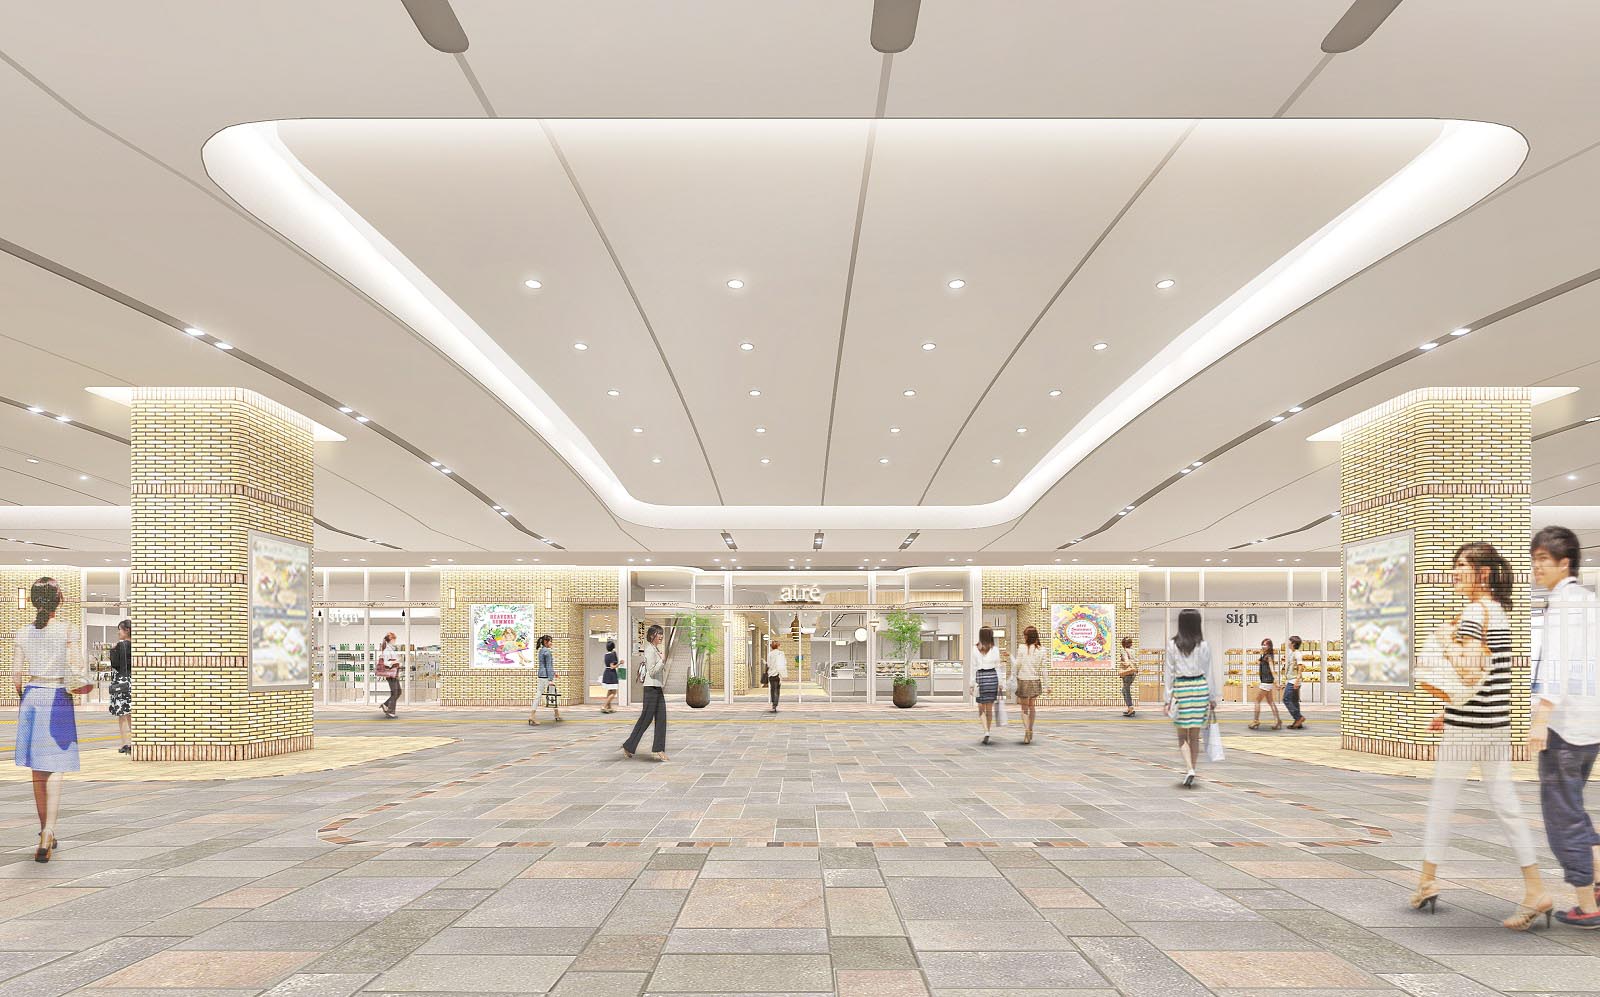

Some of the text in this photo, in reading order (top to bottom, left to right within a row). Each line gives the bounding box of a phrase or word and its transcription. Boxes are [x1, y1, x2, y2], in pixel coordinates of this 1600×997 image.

[780, 583, 820, 601] atré
[328, 609, 359, 627] sign
[1226, 609, 1259, 627] sign
